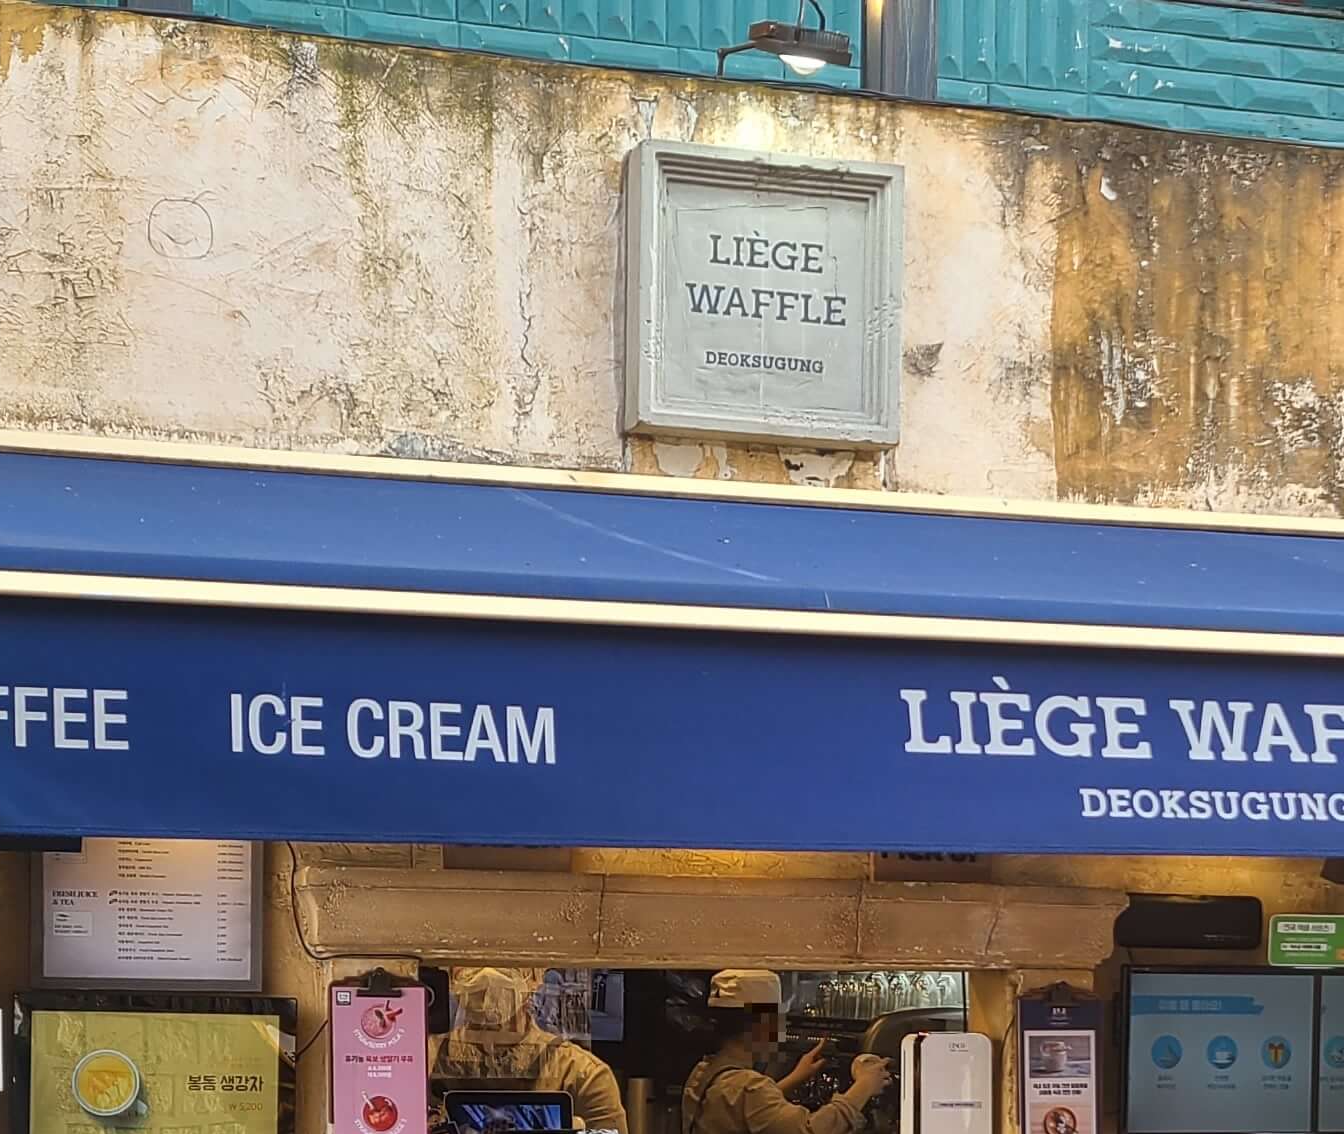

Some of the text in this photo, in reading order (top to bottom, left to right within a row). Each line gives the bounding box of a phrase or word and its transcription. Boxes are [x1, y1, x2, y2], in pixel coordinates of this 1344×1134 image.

[709, 231, 824, 274] LIÈGE
[684, 282, 848, 327] WAFFLE
[705, 350, 824, 374] DEOKSUGUNG
[230, 692, 327, 757] ICE
[346, 697, 557, 766] CREAM
[898, 675, 1153, 761] LIÈGE
